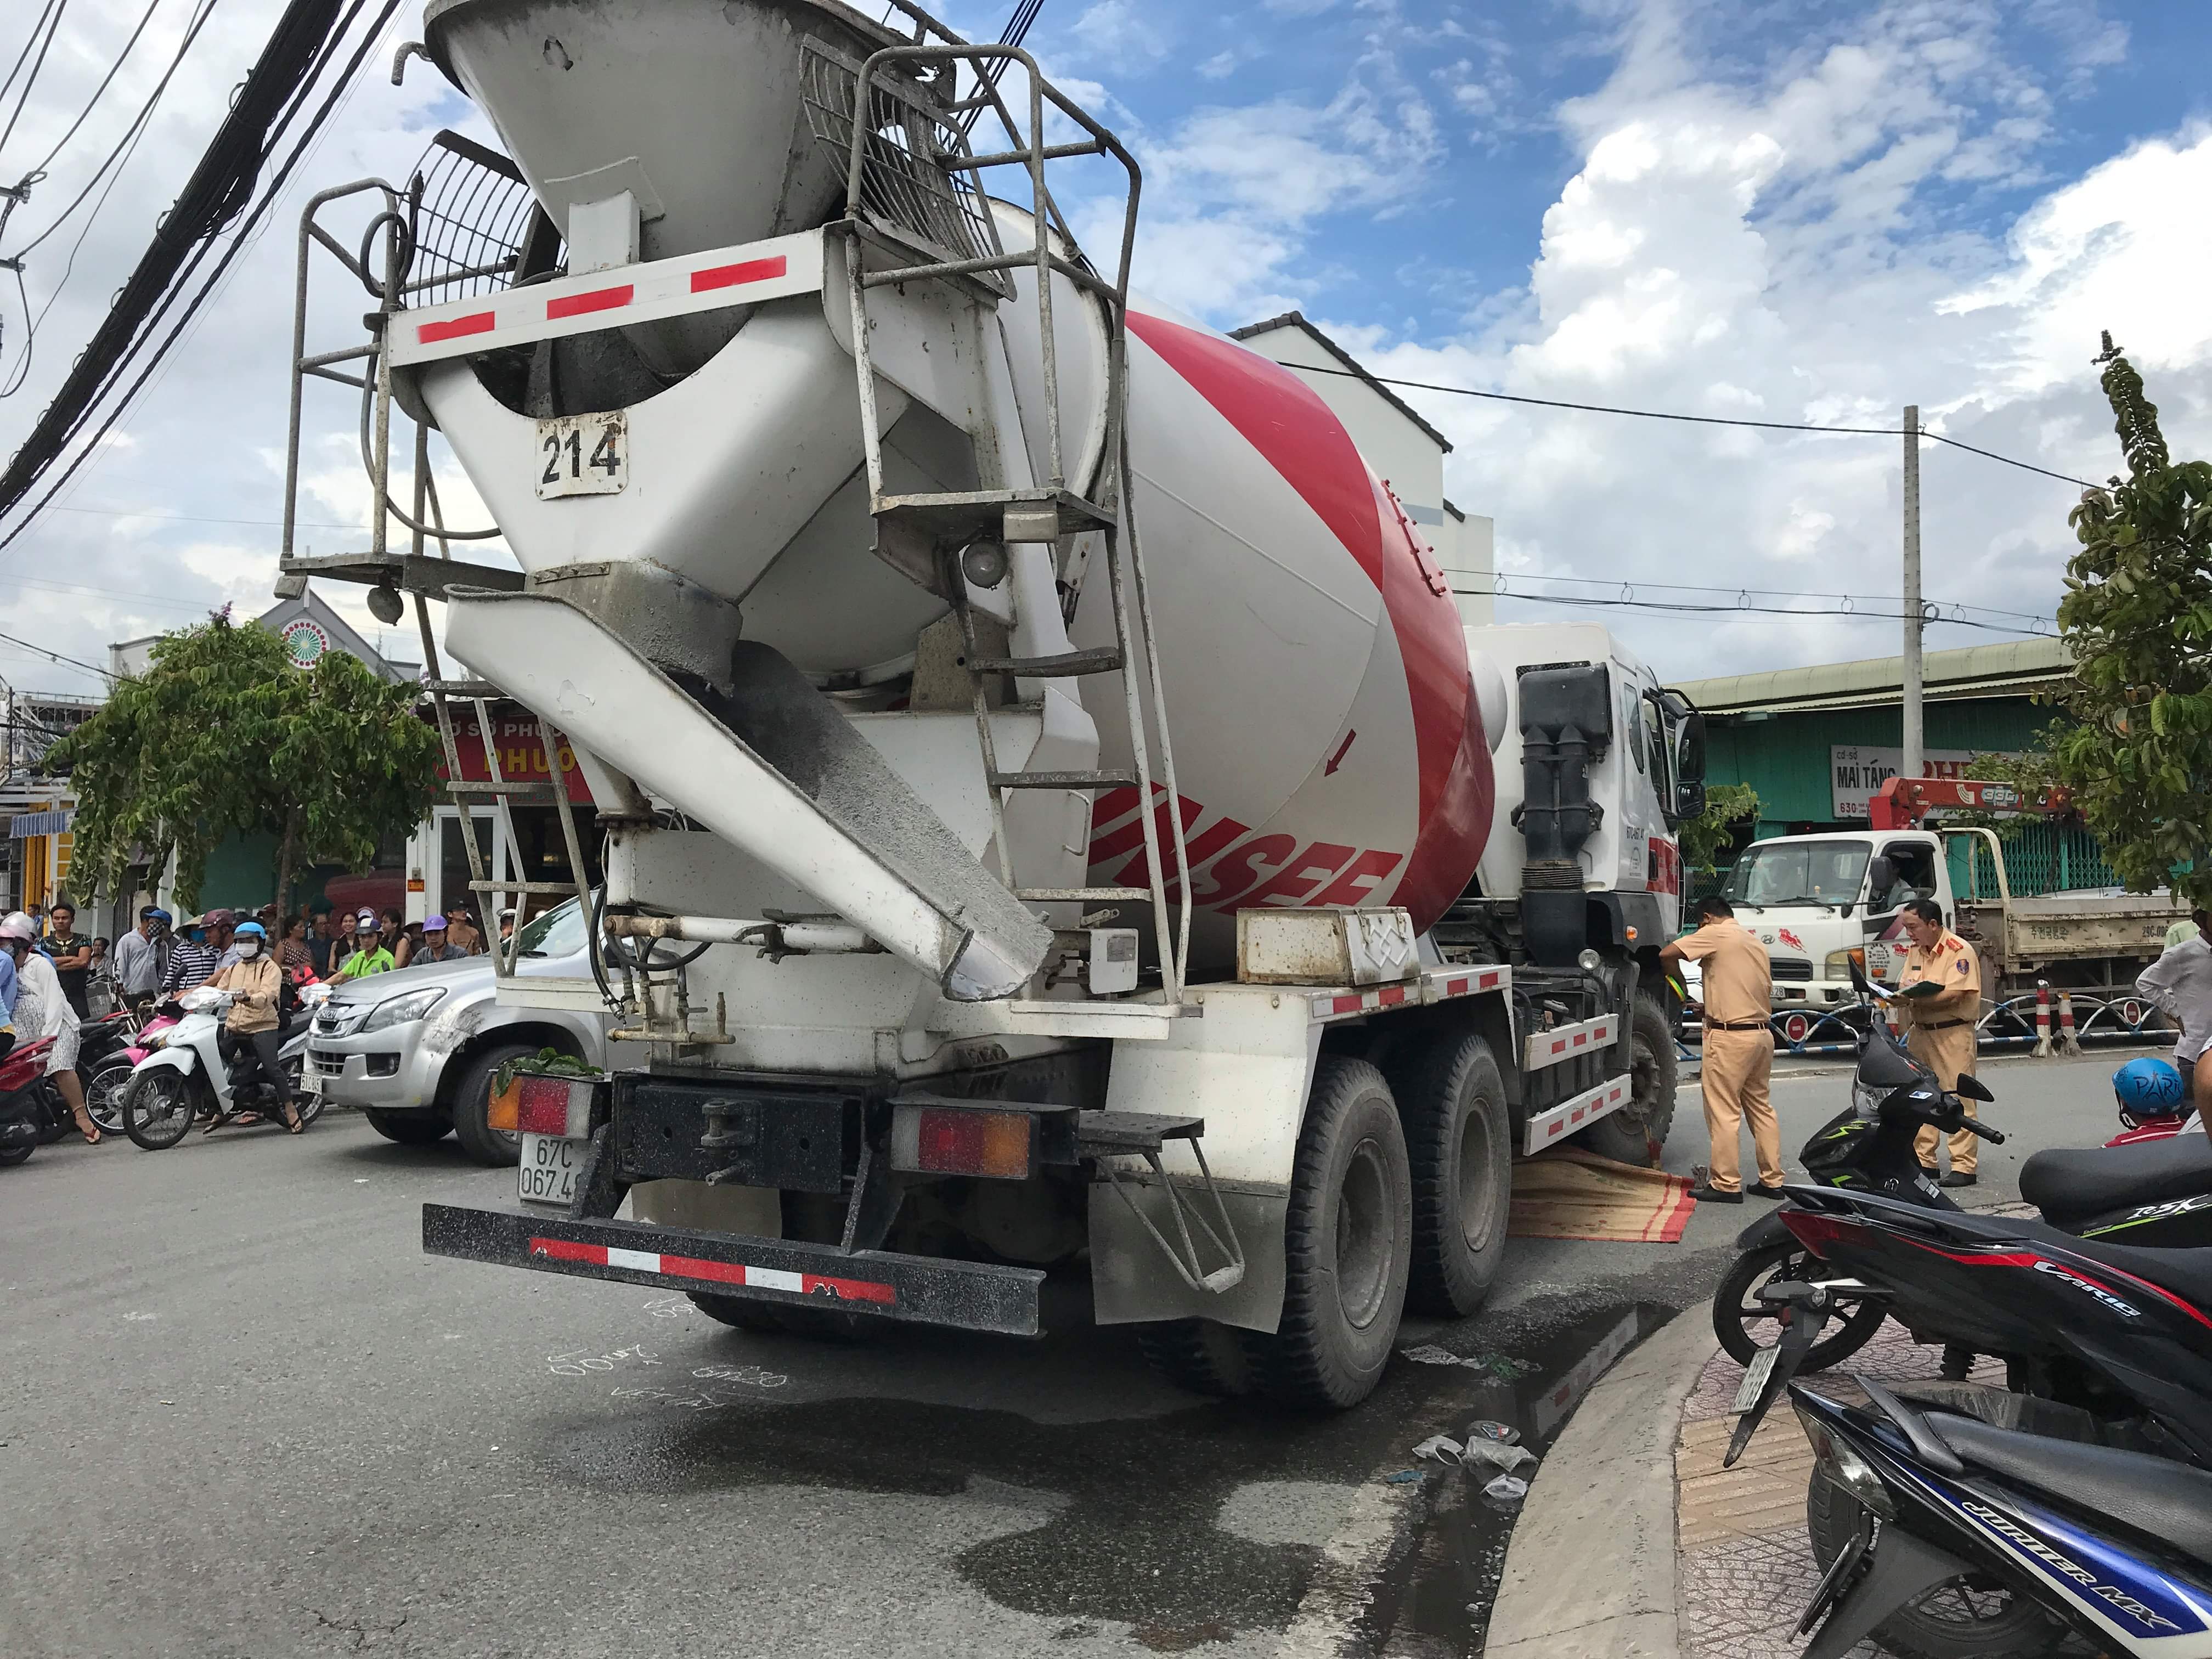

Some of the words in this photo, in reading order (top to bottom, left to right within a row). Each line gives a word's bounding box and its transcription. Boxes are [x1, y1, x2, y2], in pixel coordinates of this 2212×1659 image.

[542, 422, 621, 484] 214
[537, 1139, 573, 1168] 67C
[521, 1167, 581, 1200] 067.4
[1962, 1502, 2098, 1587] JUPITER
[2090, 1586, 2182, 1629] MX
